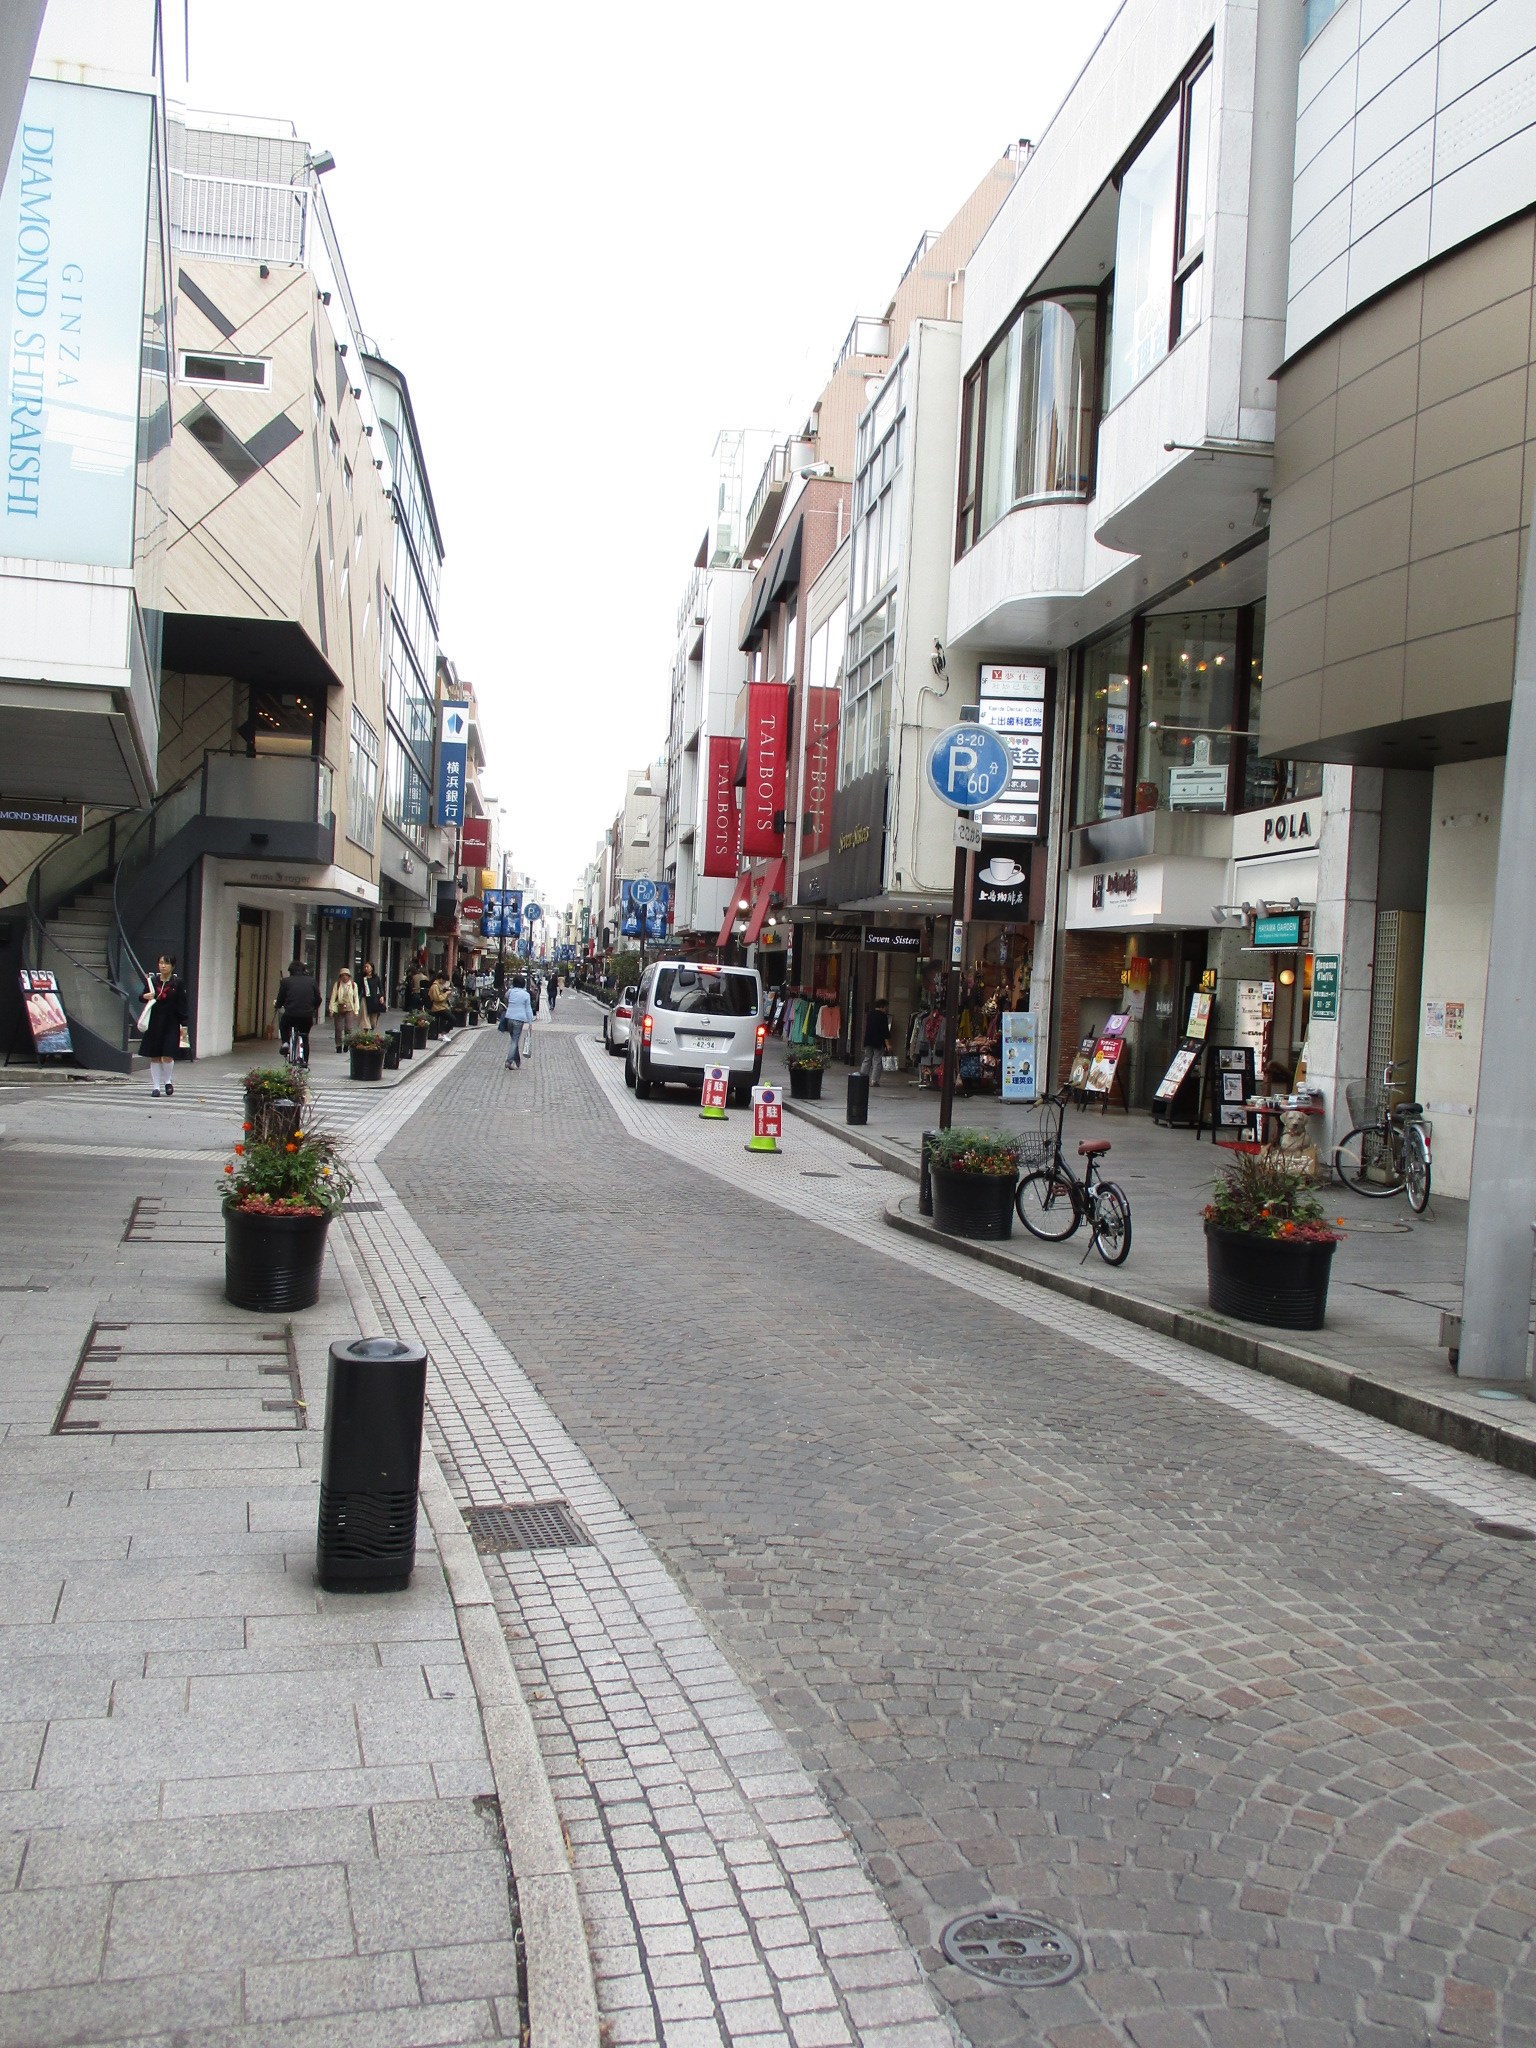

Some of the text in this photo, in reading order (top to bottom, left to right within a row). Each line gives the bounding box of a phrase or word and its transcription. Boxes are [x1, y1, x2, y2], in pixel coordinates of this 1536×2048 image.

[7, 125, 54, 518] DIAMOND SHIRAISHI
[57, 263, 84, 389] GINZA
[988, 716, 1042, 727] 上出歯科医院
[956, 733, 985, 746] 8-20
[756, 715, 776, 831] TALBOTS
[947, 745, 978, 793] P
[989, 762, 999, 775] 分
[444, 761, 460, 817] 横浜銀行
[967, 773, 989, 794] 60
[32, 812, 78, 824] SHIRAISHI
[715, 761, 729, 856] TALBOTS
[957, 824, 981, 844] ここから
[1263, 811, 1311, 842] POLA
[637, 885, 647, 899] P
[1277, 922, 1297, 931] GARDEN
[866, 934, 920, 946] Seven Sisters
[711, 1081, 724, 1105] 駐車
[766, 1106, 778, 1135] 駐車
